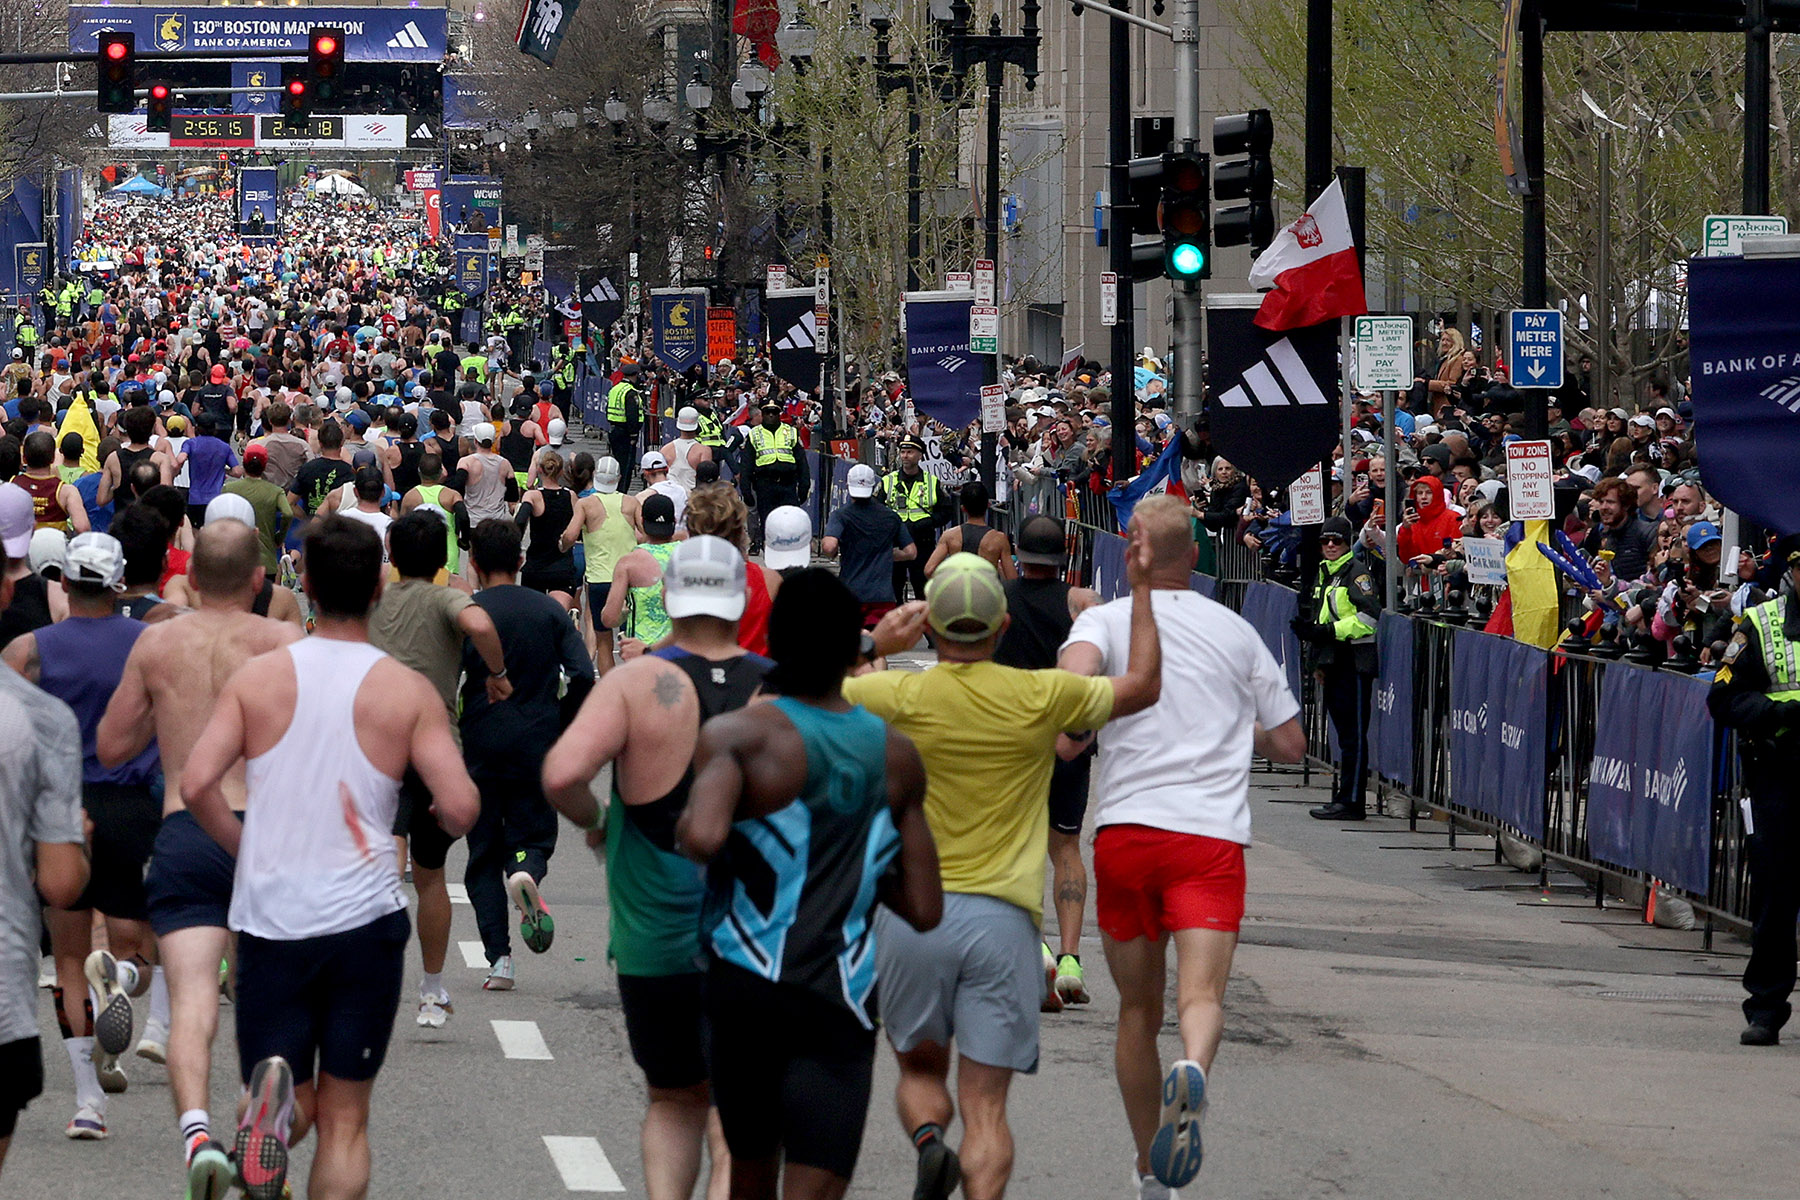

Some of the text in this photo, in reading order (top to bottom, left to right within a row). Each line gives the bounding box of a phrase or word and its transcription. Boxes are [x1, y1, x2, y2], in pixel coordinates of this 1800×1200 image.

[225, 21, 280, 35] BOSTON
[195, 39, 292, 47] BANK OF AMERICA
[1710, 221, 1727, 239] 2
[1525, 316, 1547, 327] PAY
[1360, 321, 1371, 335] 2
[1516, 331, 1556, 342] METER
[912, 346, 935, 354] BANK
[1521, 346, 1552, 357] HERE
[1703, 358, 1756, 374] BANK
[1762, 354, 1786, 369] OF
[1509, 446, 1548, 456] TOW ZONE
[1522, 462, 1536, 471] NO
[1512, 472, 1549, 480] STOPPING
